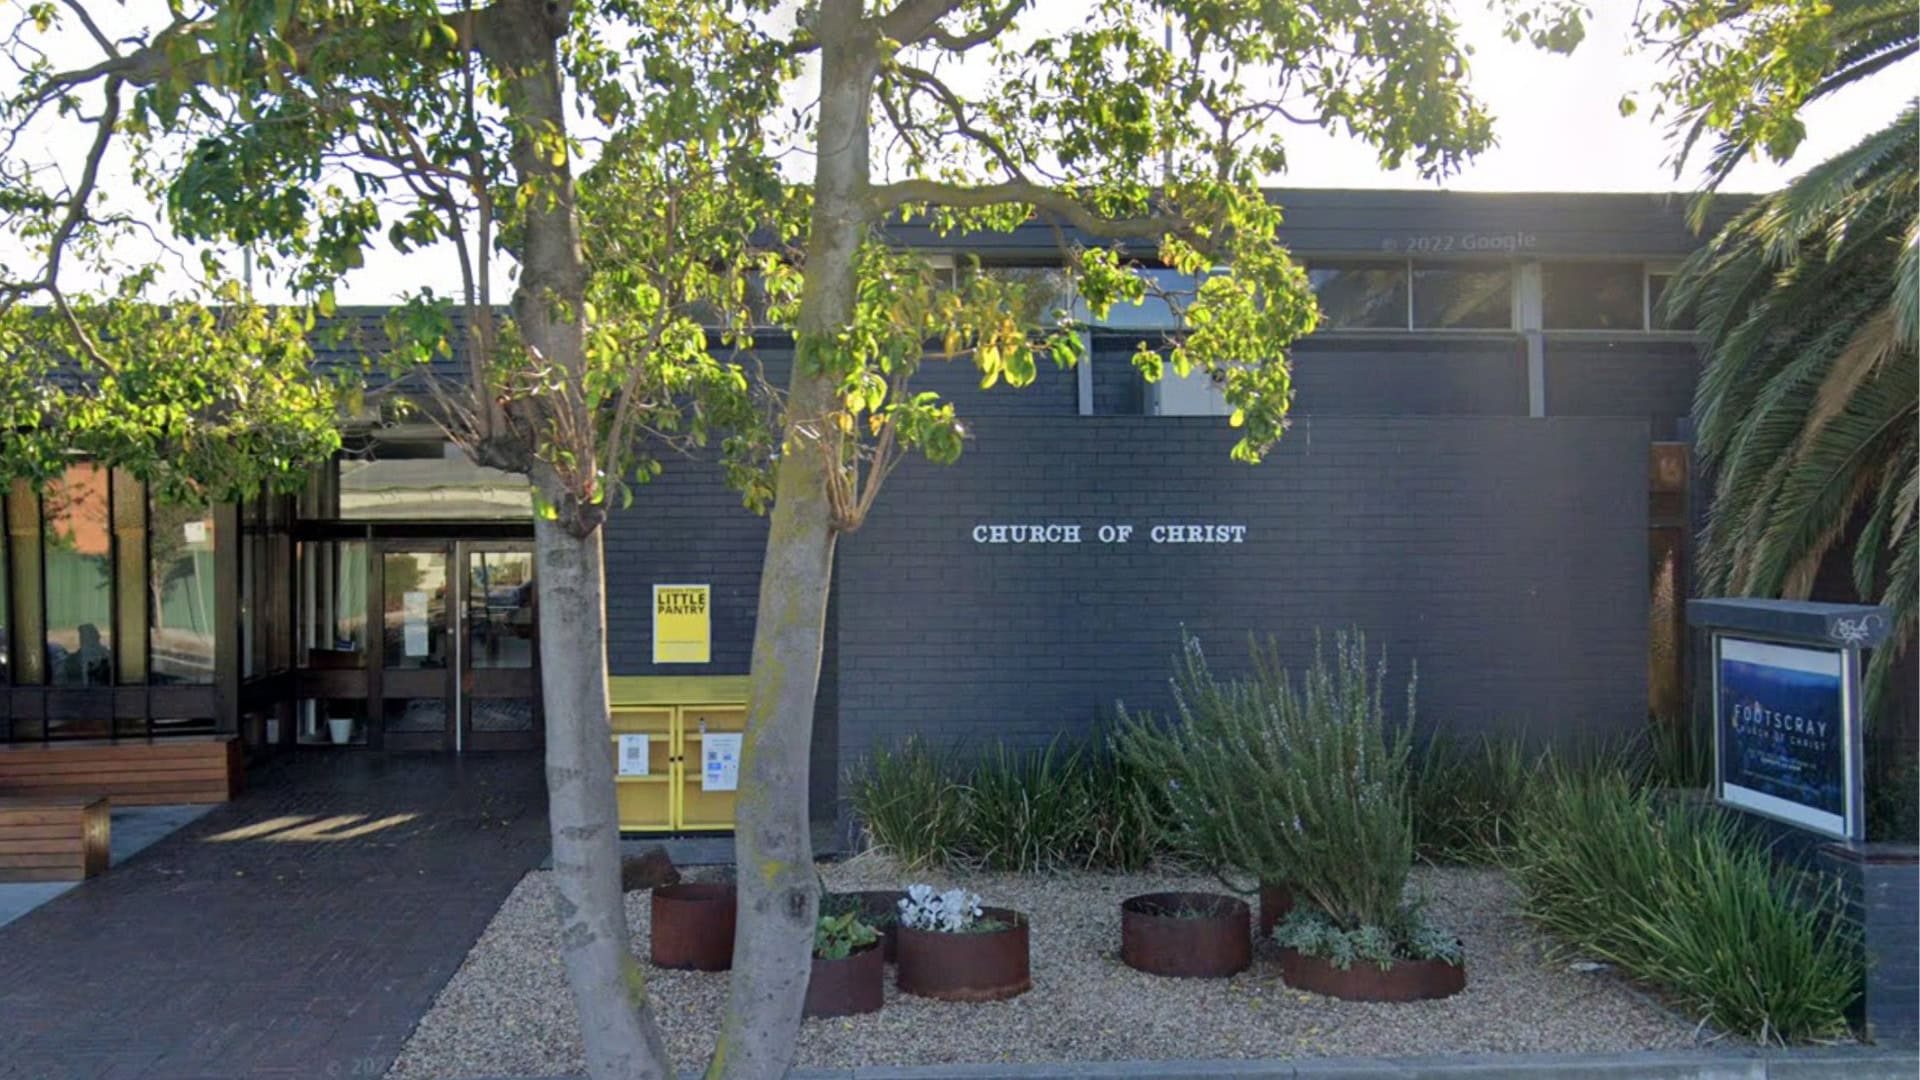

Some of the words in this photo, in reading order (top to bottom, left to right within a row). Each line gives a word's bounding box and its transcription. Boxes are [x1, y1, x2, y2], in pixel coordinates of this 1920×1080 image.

[972, 525, 1081, 543] CHURCH
[1098, 525, 1133, 543] OF
[1150, 525, 1247, 543] CHRIST
[658, 593, 705, 605] LITTLE
[658, 605, 705, 615] PANTRY
[1733, 703, 1828, 738] FOOTSCRAY
